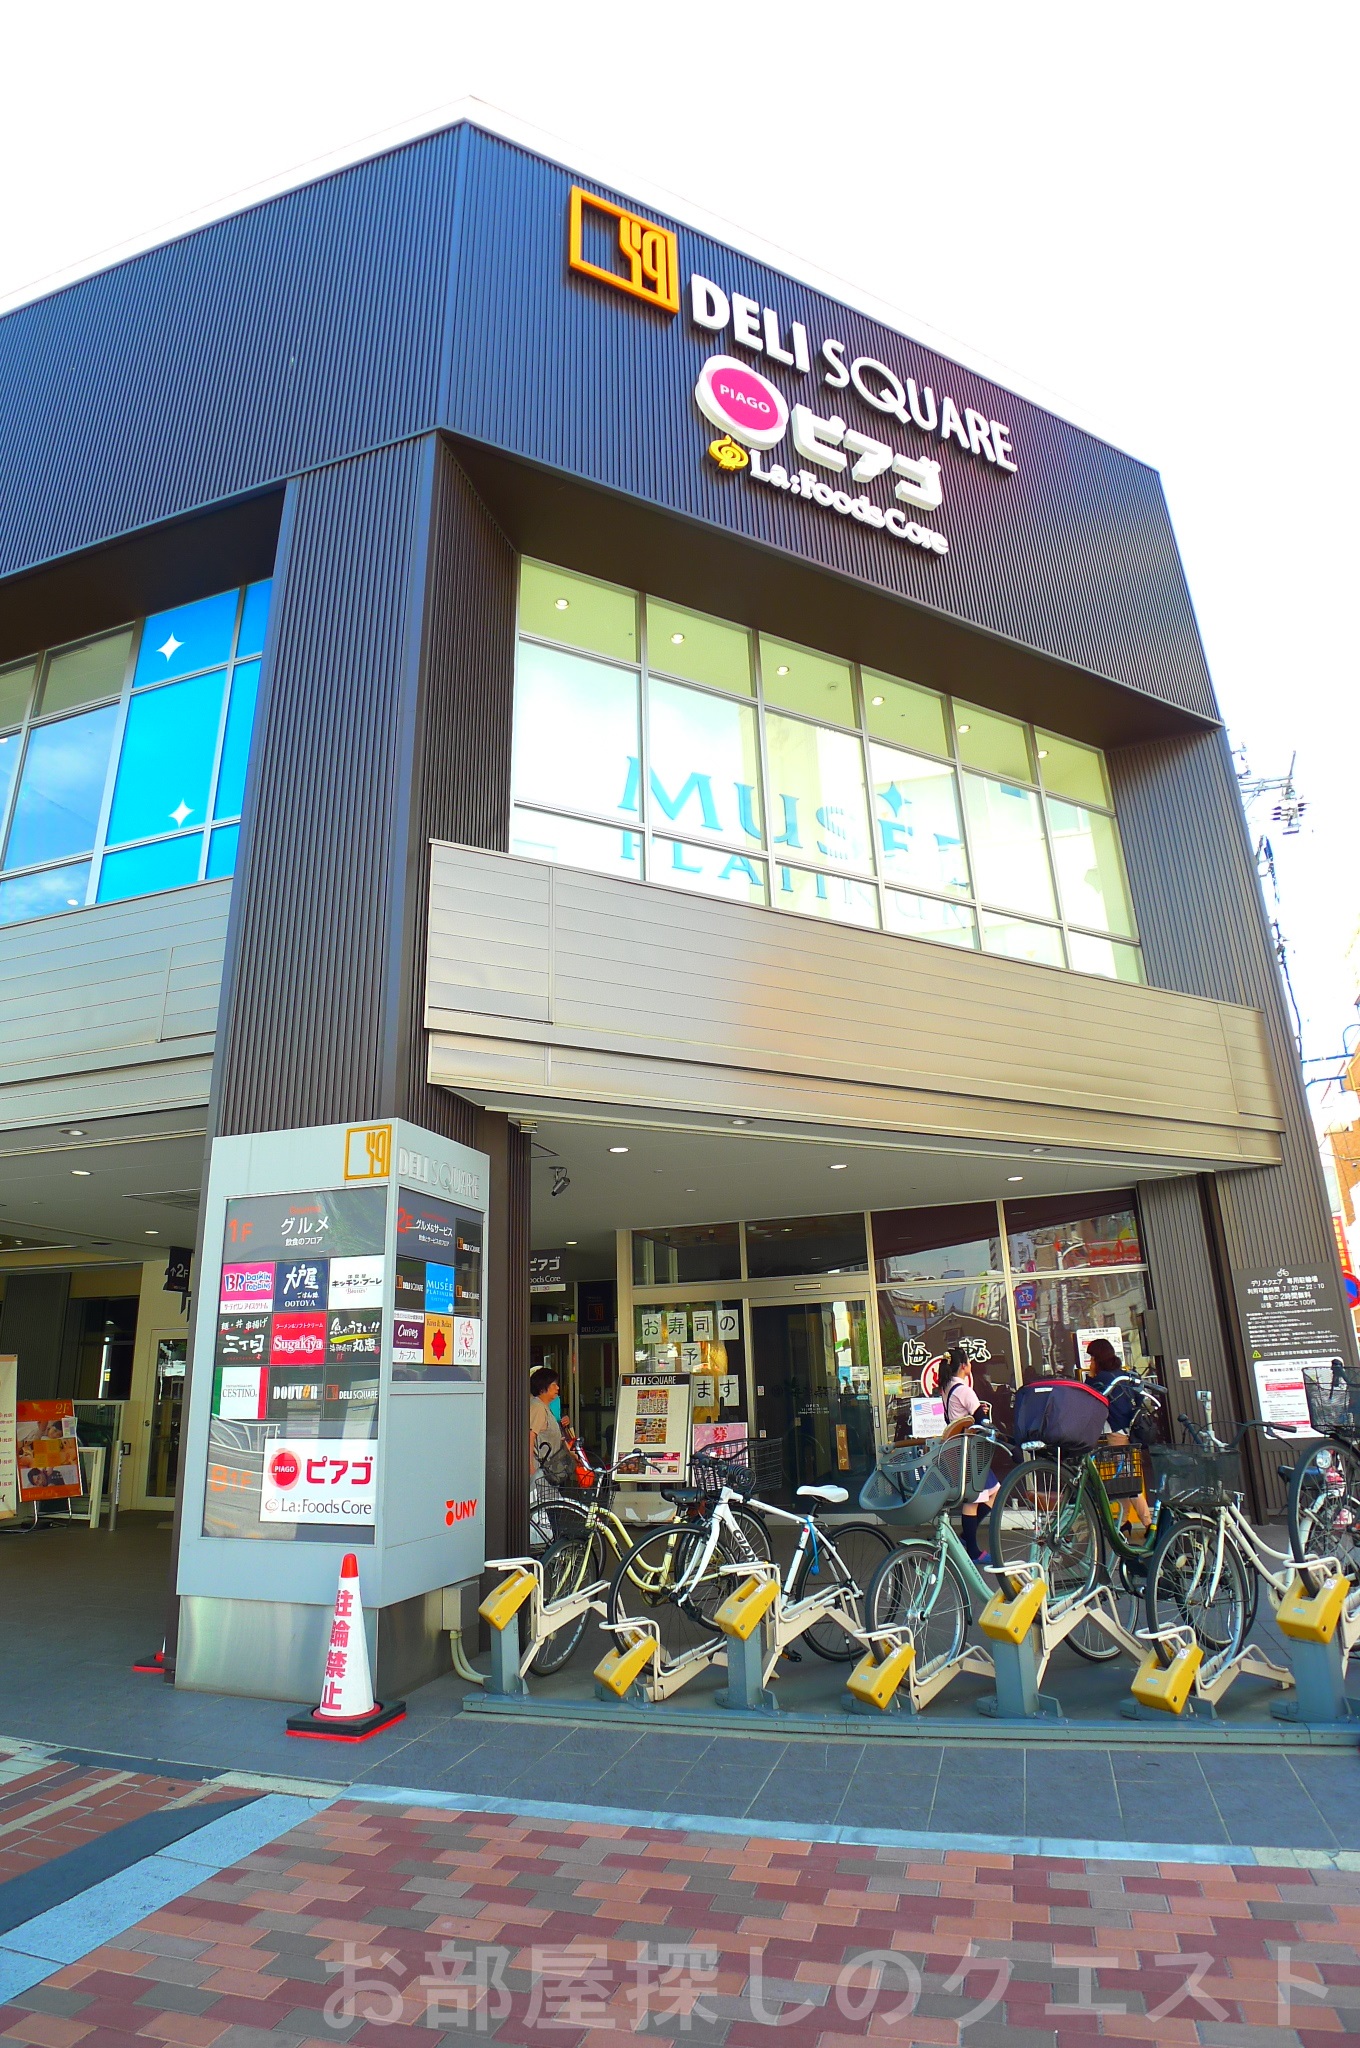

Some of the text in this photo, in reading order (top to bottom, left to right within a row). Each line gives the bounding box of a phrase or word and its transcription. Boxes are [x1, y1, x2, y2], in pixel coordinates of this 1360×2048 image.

[691, 273, 1018, 475] DELI SQUARE
[720, 384, 770, 414] PIAGO
[791, 403, 942, 512] ピアゴ
[398, 1147, 480, 1200] DELI SQUARE
[228, 1218, 254, 1242] 1F
[281, 1216, 329, 1236] グルメ
[396, 1206, 414, 1234] 2F
[285, 1236, 323, 1247] 飲食のフロア
[176, 1263, 189, 1278] 2F
[283, 1263, 319, 1294] 大戸屋
[545, 1275, 561, 1283] Core
[224, 1273, 245, 1292] BR
[644, 1315, 736, 1336] お寿司の
[222, 1334, 265, 1354] 三丁目
[273, 1334, 324, 1354] Sugakiya
[630, 1376, 676, 1386] DELI SQUARE
[339, 1389, 379, 1400] DELI SQUARE
[210, 1465, 253, 1493] B1F
[274, 1465, 295, 1473] PIAGO
[306, 1456, 374, 1485] ピアゴ
[341, 1499, 372, 1515] Core
[455, 1498, 477, 1520] UNY
[321, 1589, 354, 1711] 駐輪禁止
